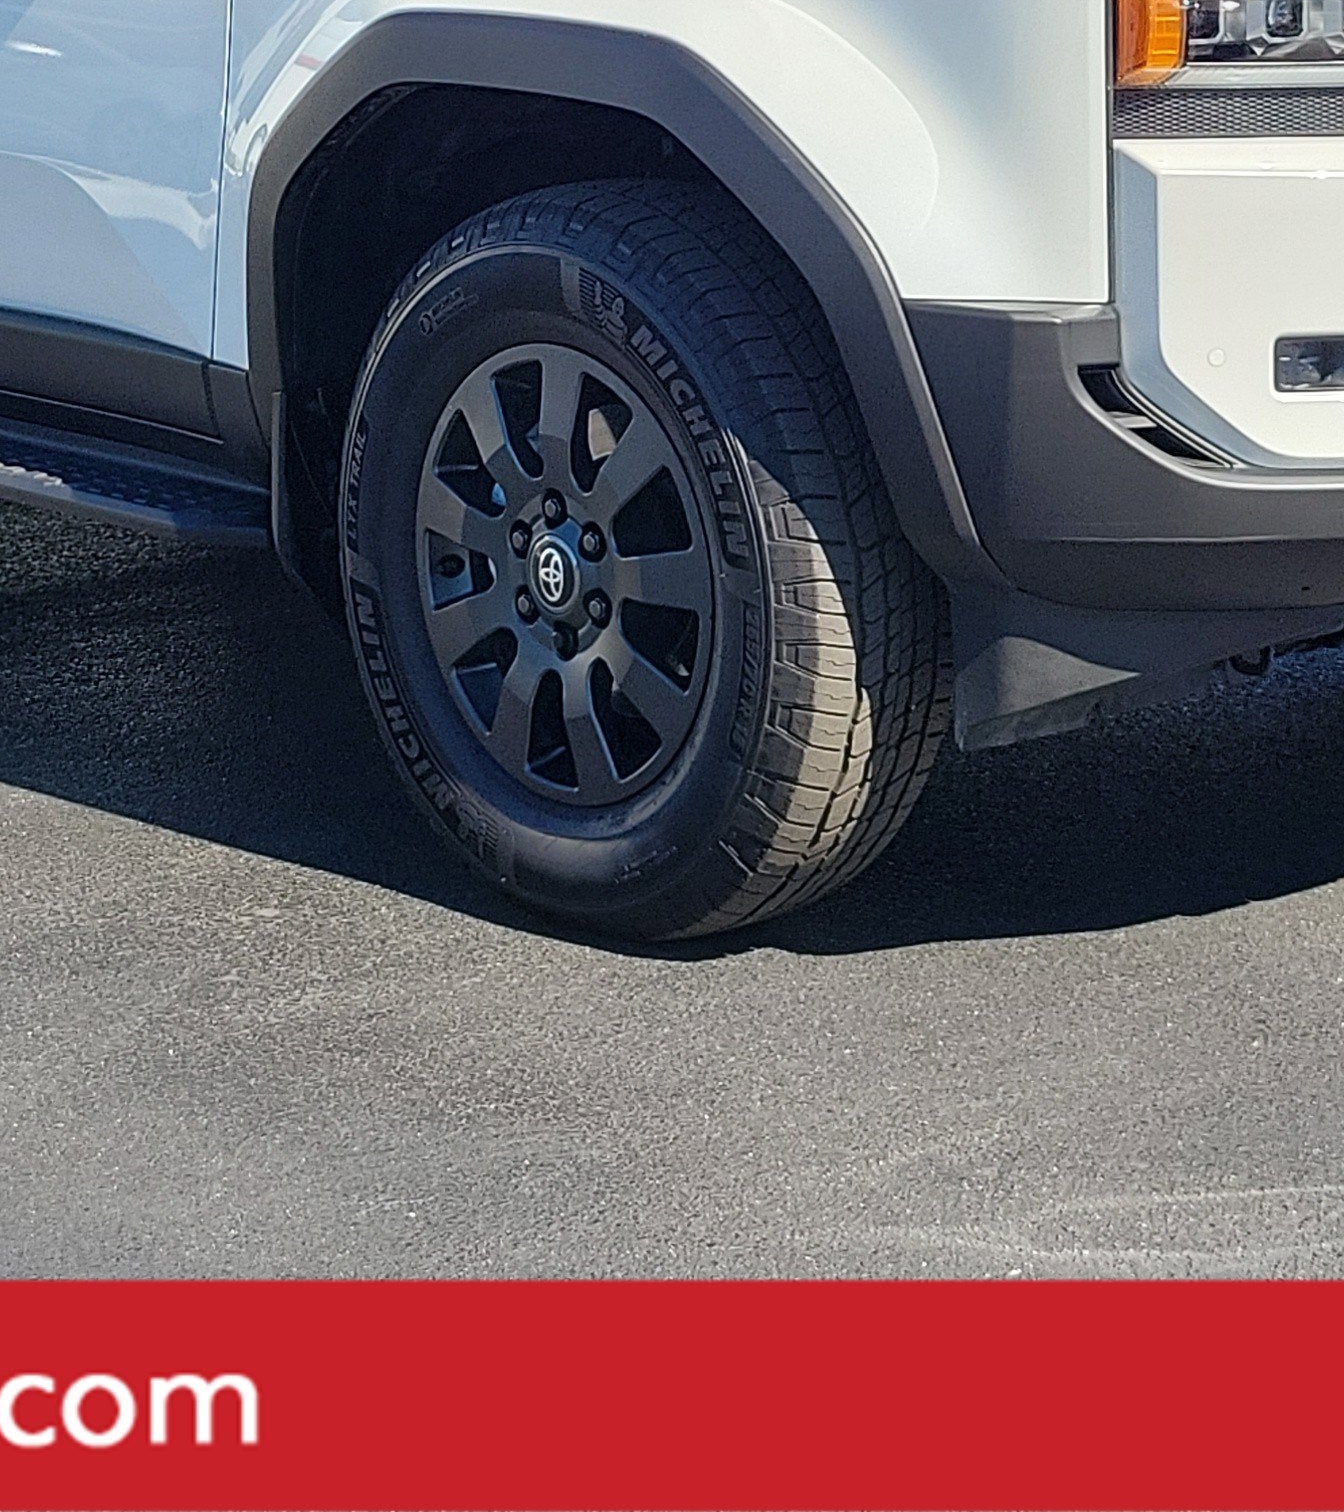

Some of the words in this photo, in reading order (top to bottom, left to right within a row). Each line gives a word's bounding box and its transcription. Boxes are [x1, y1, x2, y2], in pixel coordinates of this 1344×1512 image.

[351, 431, 367, 485] TRAIL
[630, 324, 750, 558] MICHELIN
[353, 578, 456, 813] MICHELIN
